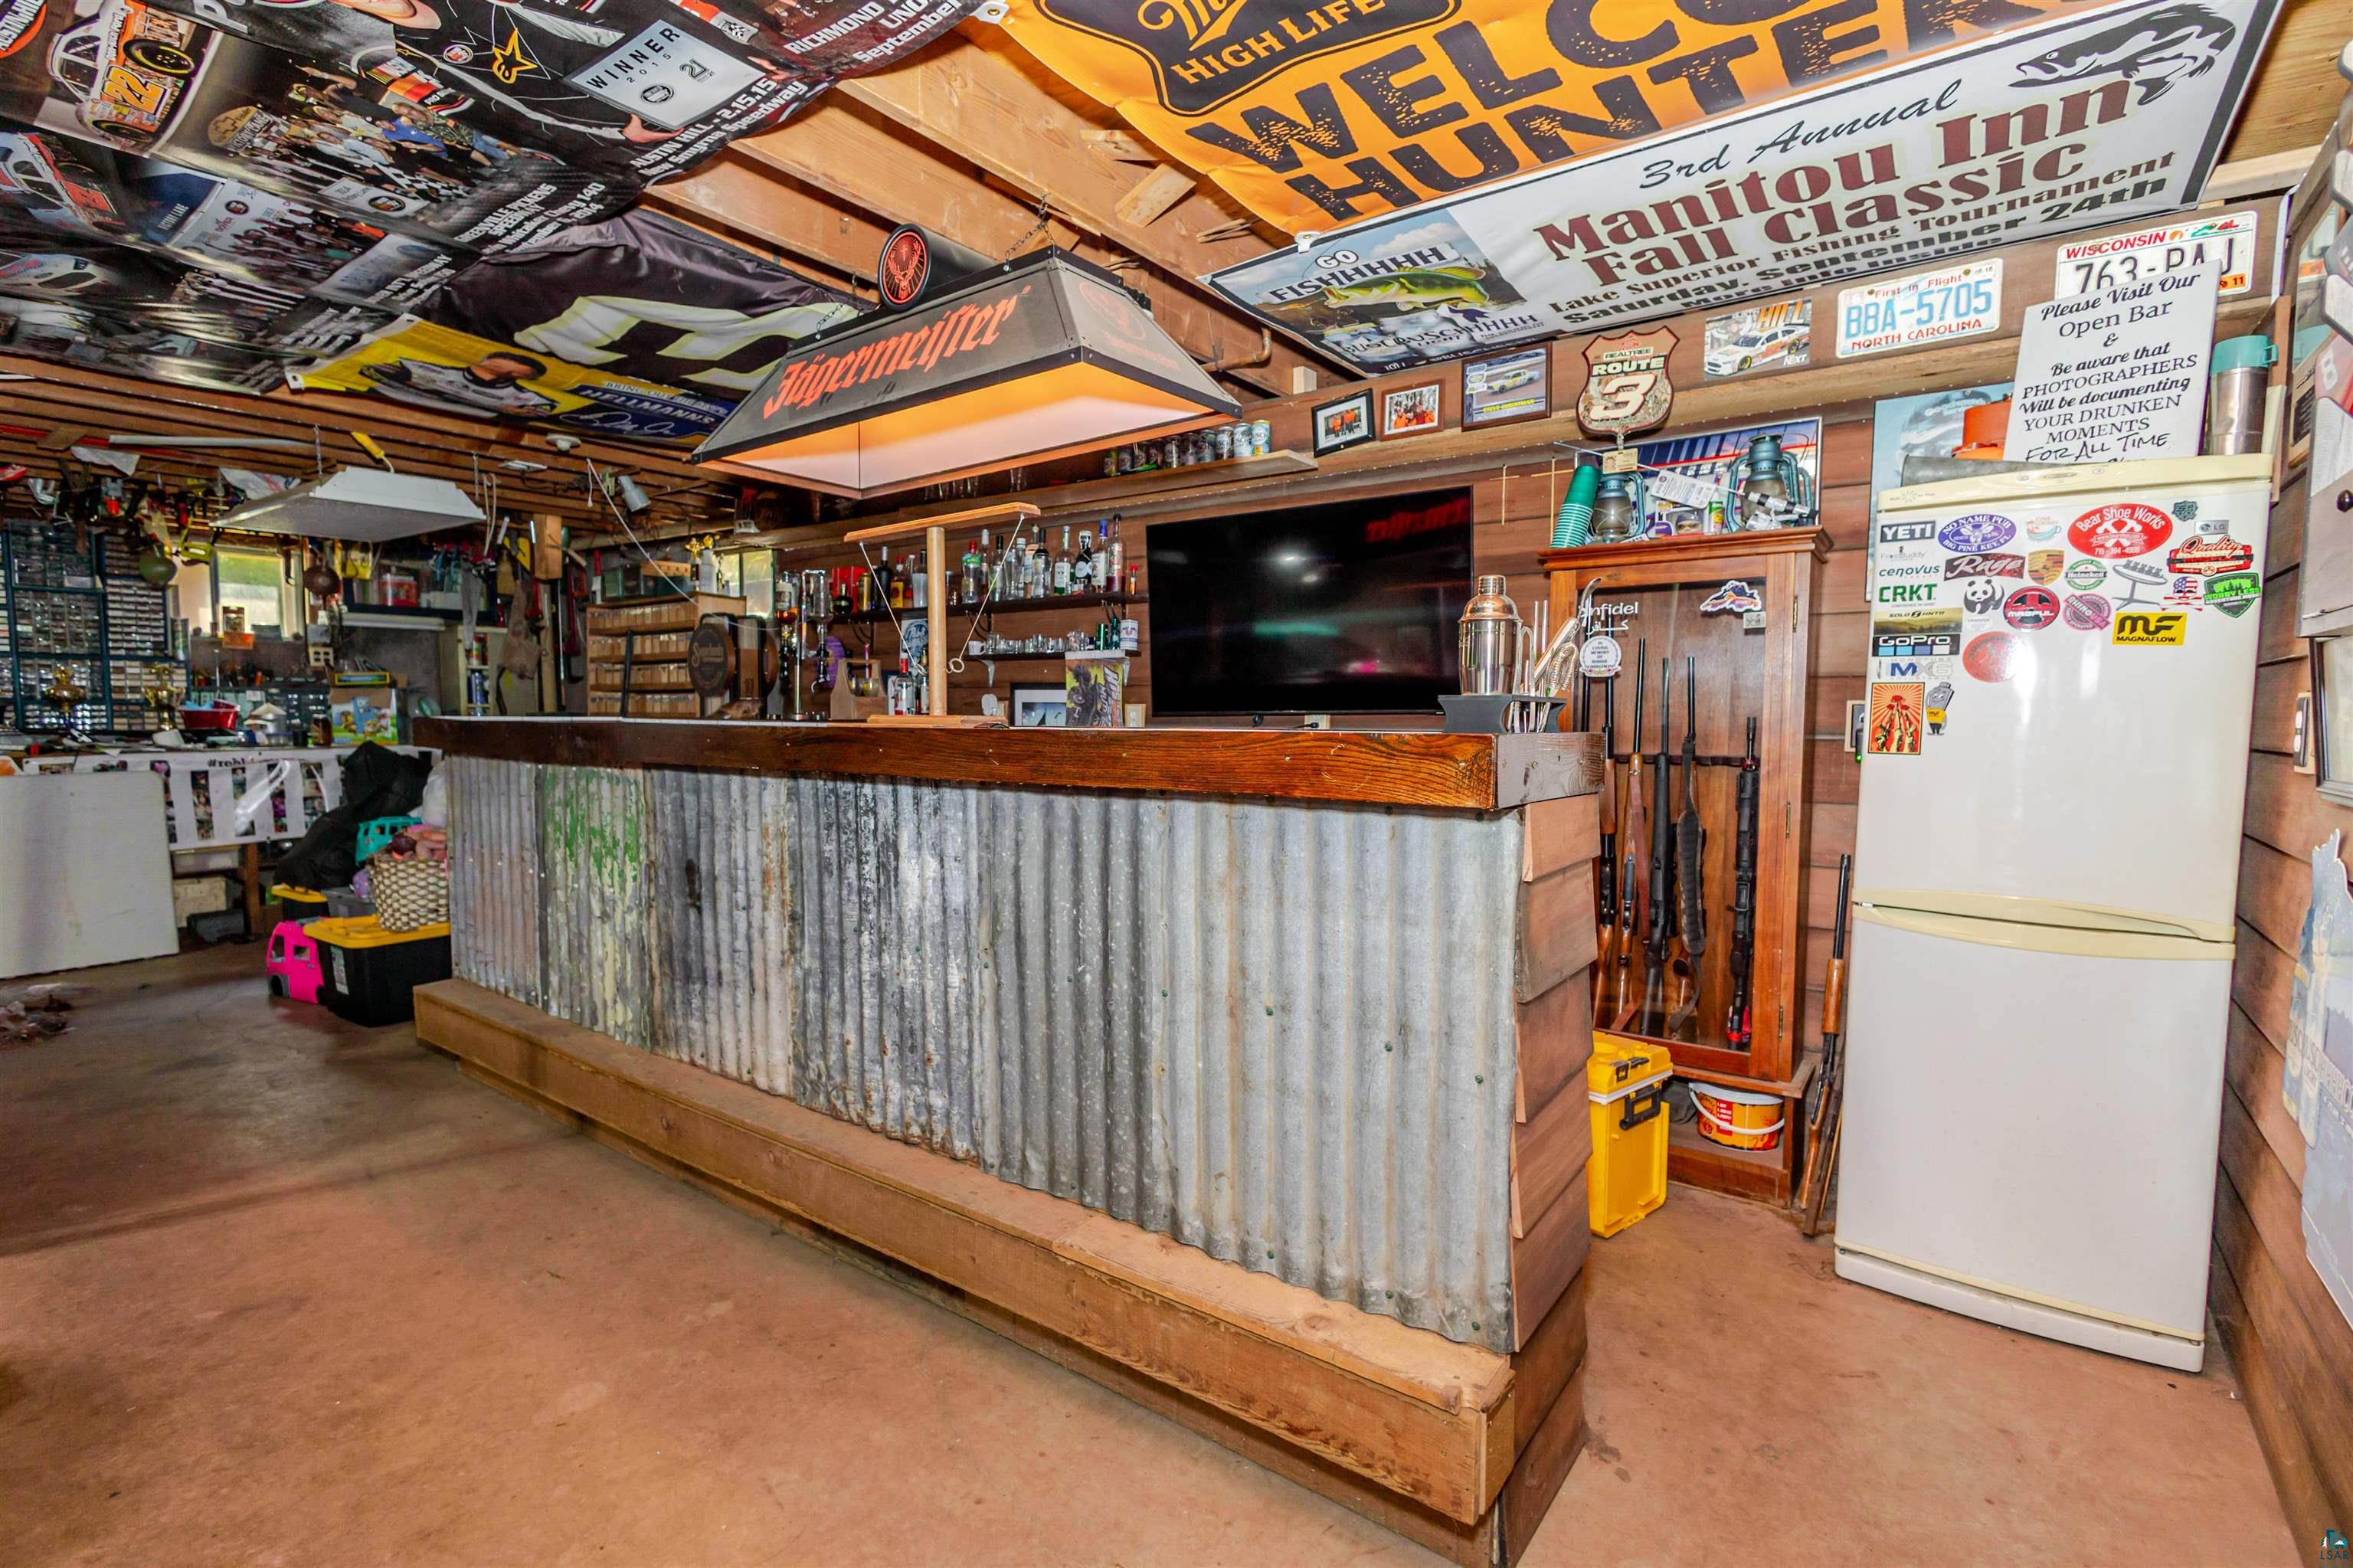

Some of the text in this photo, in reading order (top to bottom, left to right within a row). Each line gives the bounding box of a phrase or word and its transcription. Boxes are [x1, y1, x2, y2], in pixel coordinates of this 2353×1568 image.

[784, 1, 885, 54] RICHMOND
[1170, 31, 1286, 83] HIGH
[1278, 0, 1386, 44] LIFE
[587, 28, 680, 90] WINNER
[627, 53, 673, 83] 2015
[101, 64, 170, 116] 22
[630, 78, 778, 169] AUSTIN HILL 2.15.15
[638, 80, 809, 177] New Smyrna Speedway
[1639, 79, 1962, 189] 3rd Annual
[1533, 79, 2135, 262] Manitou Inn
[576, 182, 607, 202] 140
[1581, 144, 2087, 286] Fall Classic
[1756, 215, 2027, 282] September
[2040, 174, 2169, 224] 24th
[1549, 151, 2176, 313] Lake Superior Fishing Tournament
[2067, 231, 2167, 259] WISCONSIN
[1315, 249, 1360, 269] GO
[1874, 286, 1901, 298] First
[1928, 274, 1962, 288] Flight
[2041, 273, 2201, 321] Please Visit Our
[1756, 299, 1805, 329] HILL
[1845, 278, 1993, 339] BBA-5705
[2059, 301, 2173, 339] Open Bar
[1851, 319, 1982, 351] NORTH CAROLINA
[2103, 332, 2119, 348] &
[763, 294, 1019, 420] Jägermeister
[1592, 355, 1666, 376] ROUTE
[1605, 348, 1652, 359] REALTREE
[1783, 354, 1808, 366] NEXT
[2050, 342, 2171, 377] Be aware that
[2021, 354, 2198, 399] PHOTOGRAPHERS
[1589, 374, 1657, 421] 3
[2019, 378, 2191, 414] Will be documenting
[2024, 394, 2182, 432] YOUR DRUNKEN
[2046, 417, 2151, 445] MOMENTS
[2025, 432, 2171, 462] FOR ALL TIME
[1883, 522, 1932, 541] YETI
[1942, 516, 2012, 535] NO NAME PUB
[2076, 506, 2165, 532] Bear Shoe Works
[1942, 539, 1957, 550] BIG
[2179, 535, 2243, 558] Quality
[1879, 565, 1941, 578] cenovus
[1946, 555, 2024, 578] Rage
[1879, 584, 1938, 603] CRKT
[2067, 596, 2093, 616] RHINO
[1879, 635, 1952, 646] GoPro
